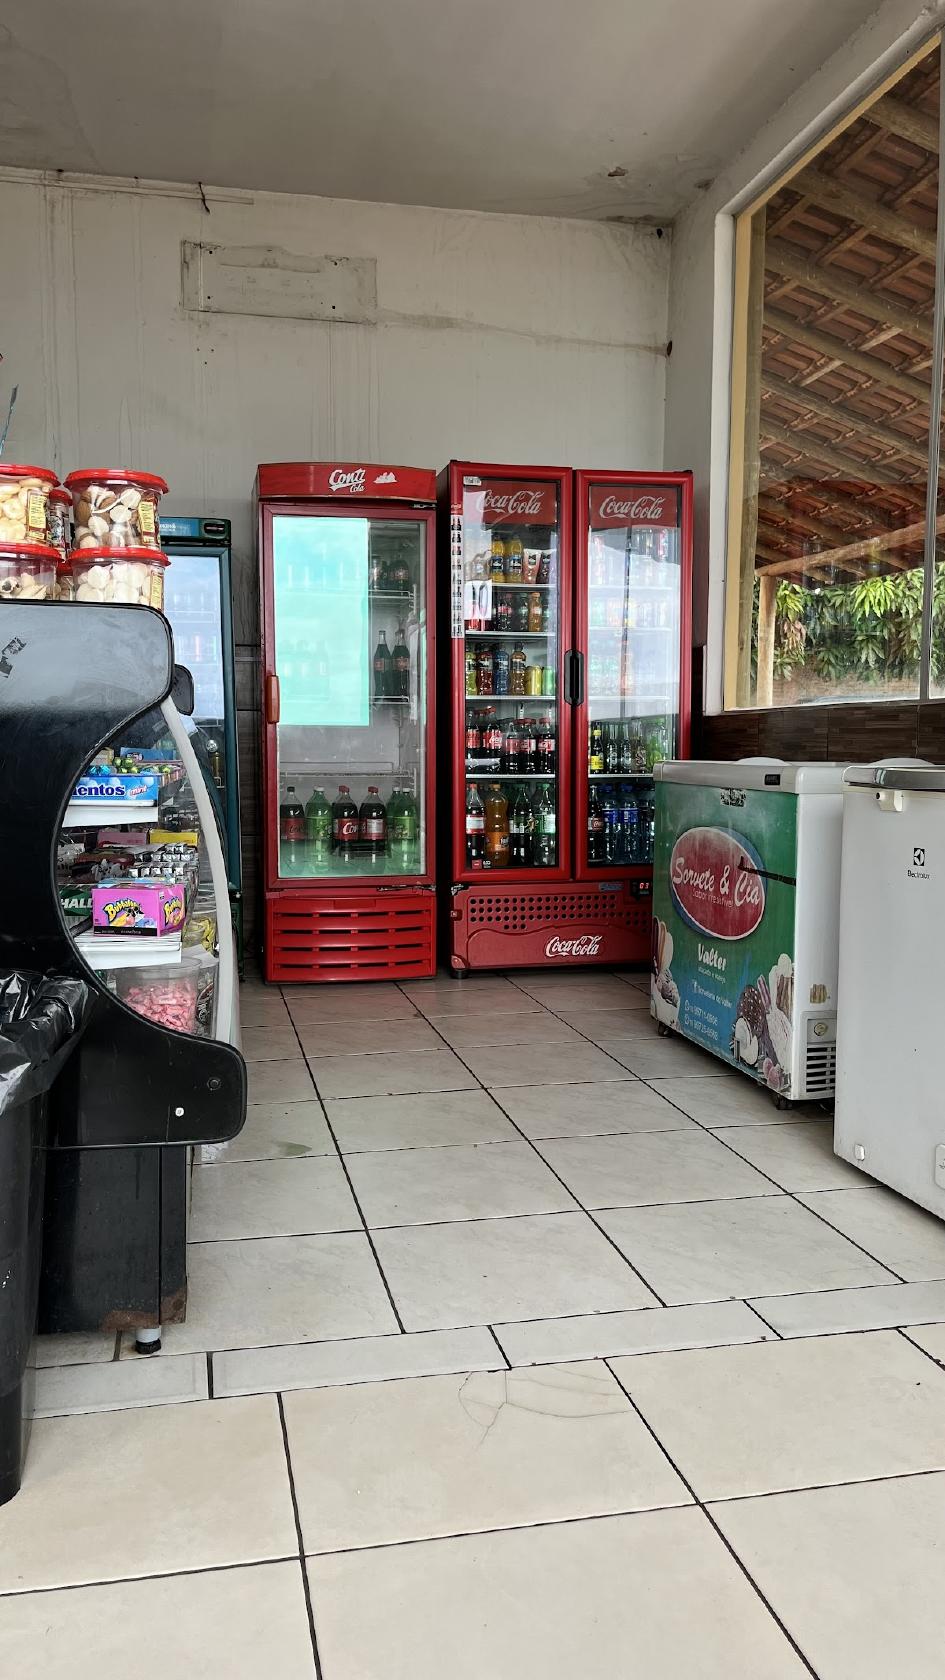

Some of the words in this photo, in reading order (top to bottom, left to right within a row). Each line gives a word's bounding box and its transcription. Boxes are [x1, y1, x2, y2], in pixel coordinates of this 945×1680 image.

[329, 468, 366, 488] Conti
[350, 483, 365, 493] Cola
[476, 490, 545, 514] Coca-Cola
[599, 496, 665, 519] Coca-Cola
[73, 784, 126, 797] entos
[672, 857, 715, 892] Sorvete
[719, 865, 730, 895] &
[735, 870, 760, 907] Cia
[545, 936, 602, 957] Coca-Cola
[698, 943, 727, 971] Valter
